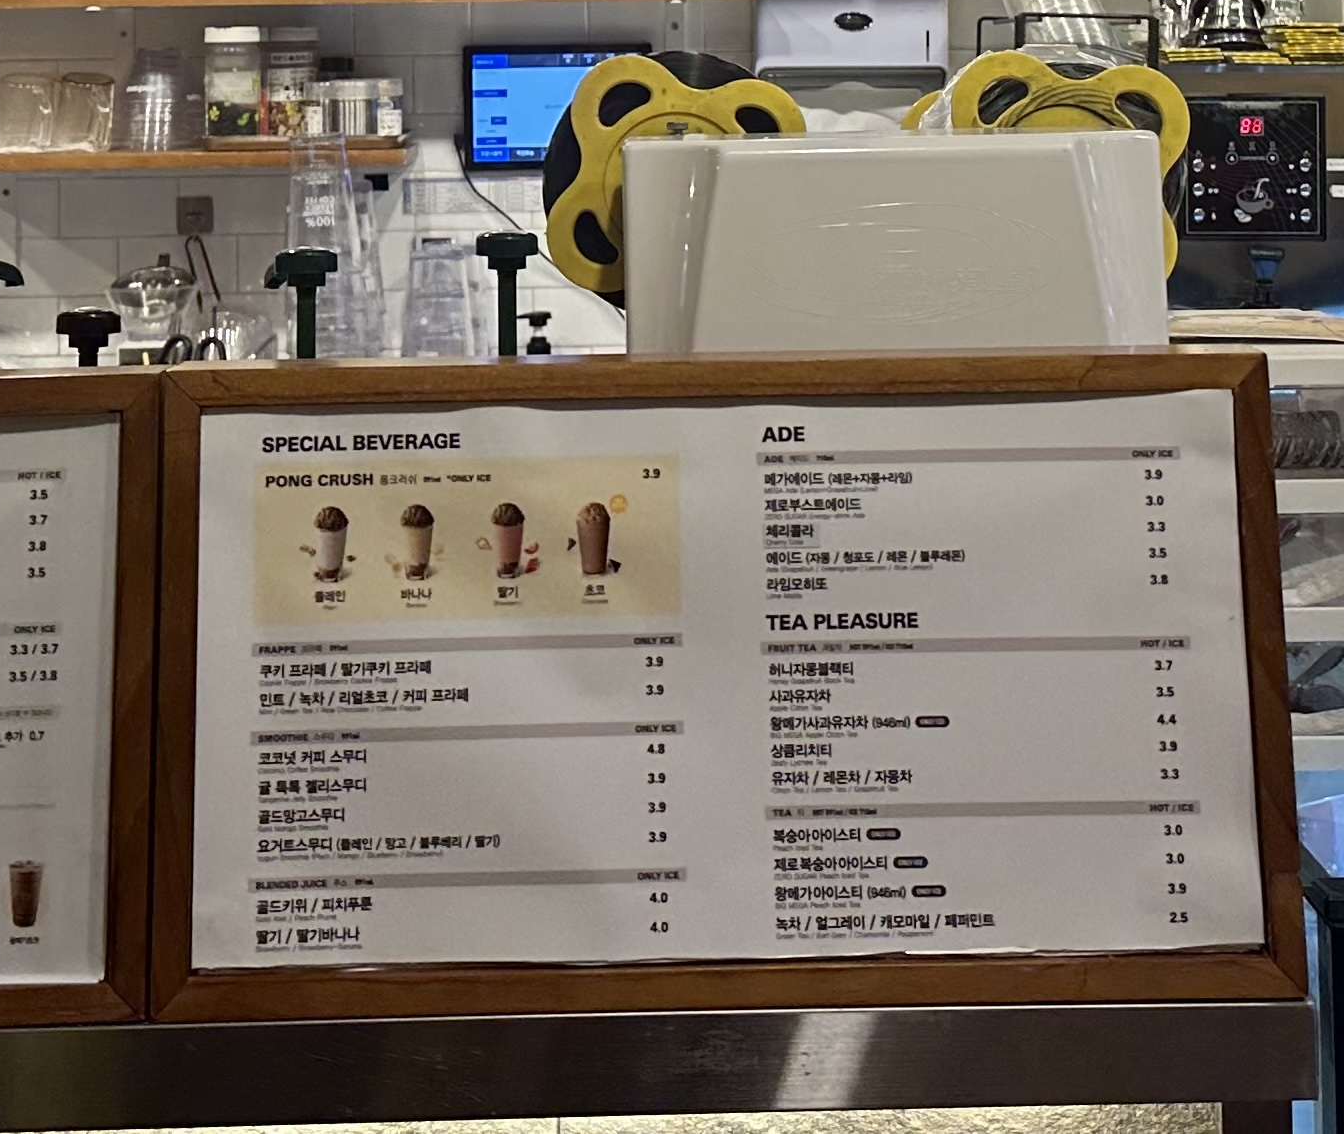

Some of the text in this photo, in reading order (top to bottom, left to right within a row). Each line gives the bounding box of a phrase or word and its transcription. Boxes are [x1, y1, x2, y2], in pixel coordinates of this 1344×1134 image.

[762, 426, 805, 442] ADE
[263, 433, 460, 453] SPECIAL BEVERAGE
[266, 473, 373, 487] PONG CRUSH
[766, 612, 918, 630] TEA PLEASURE
